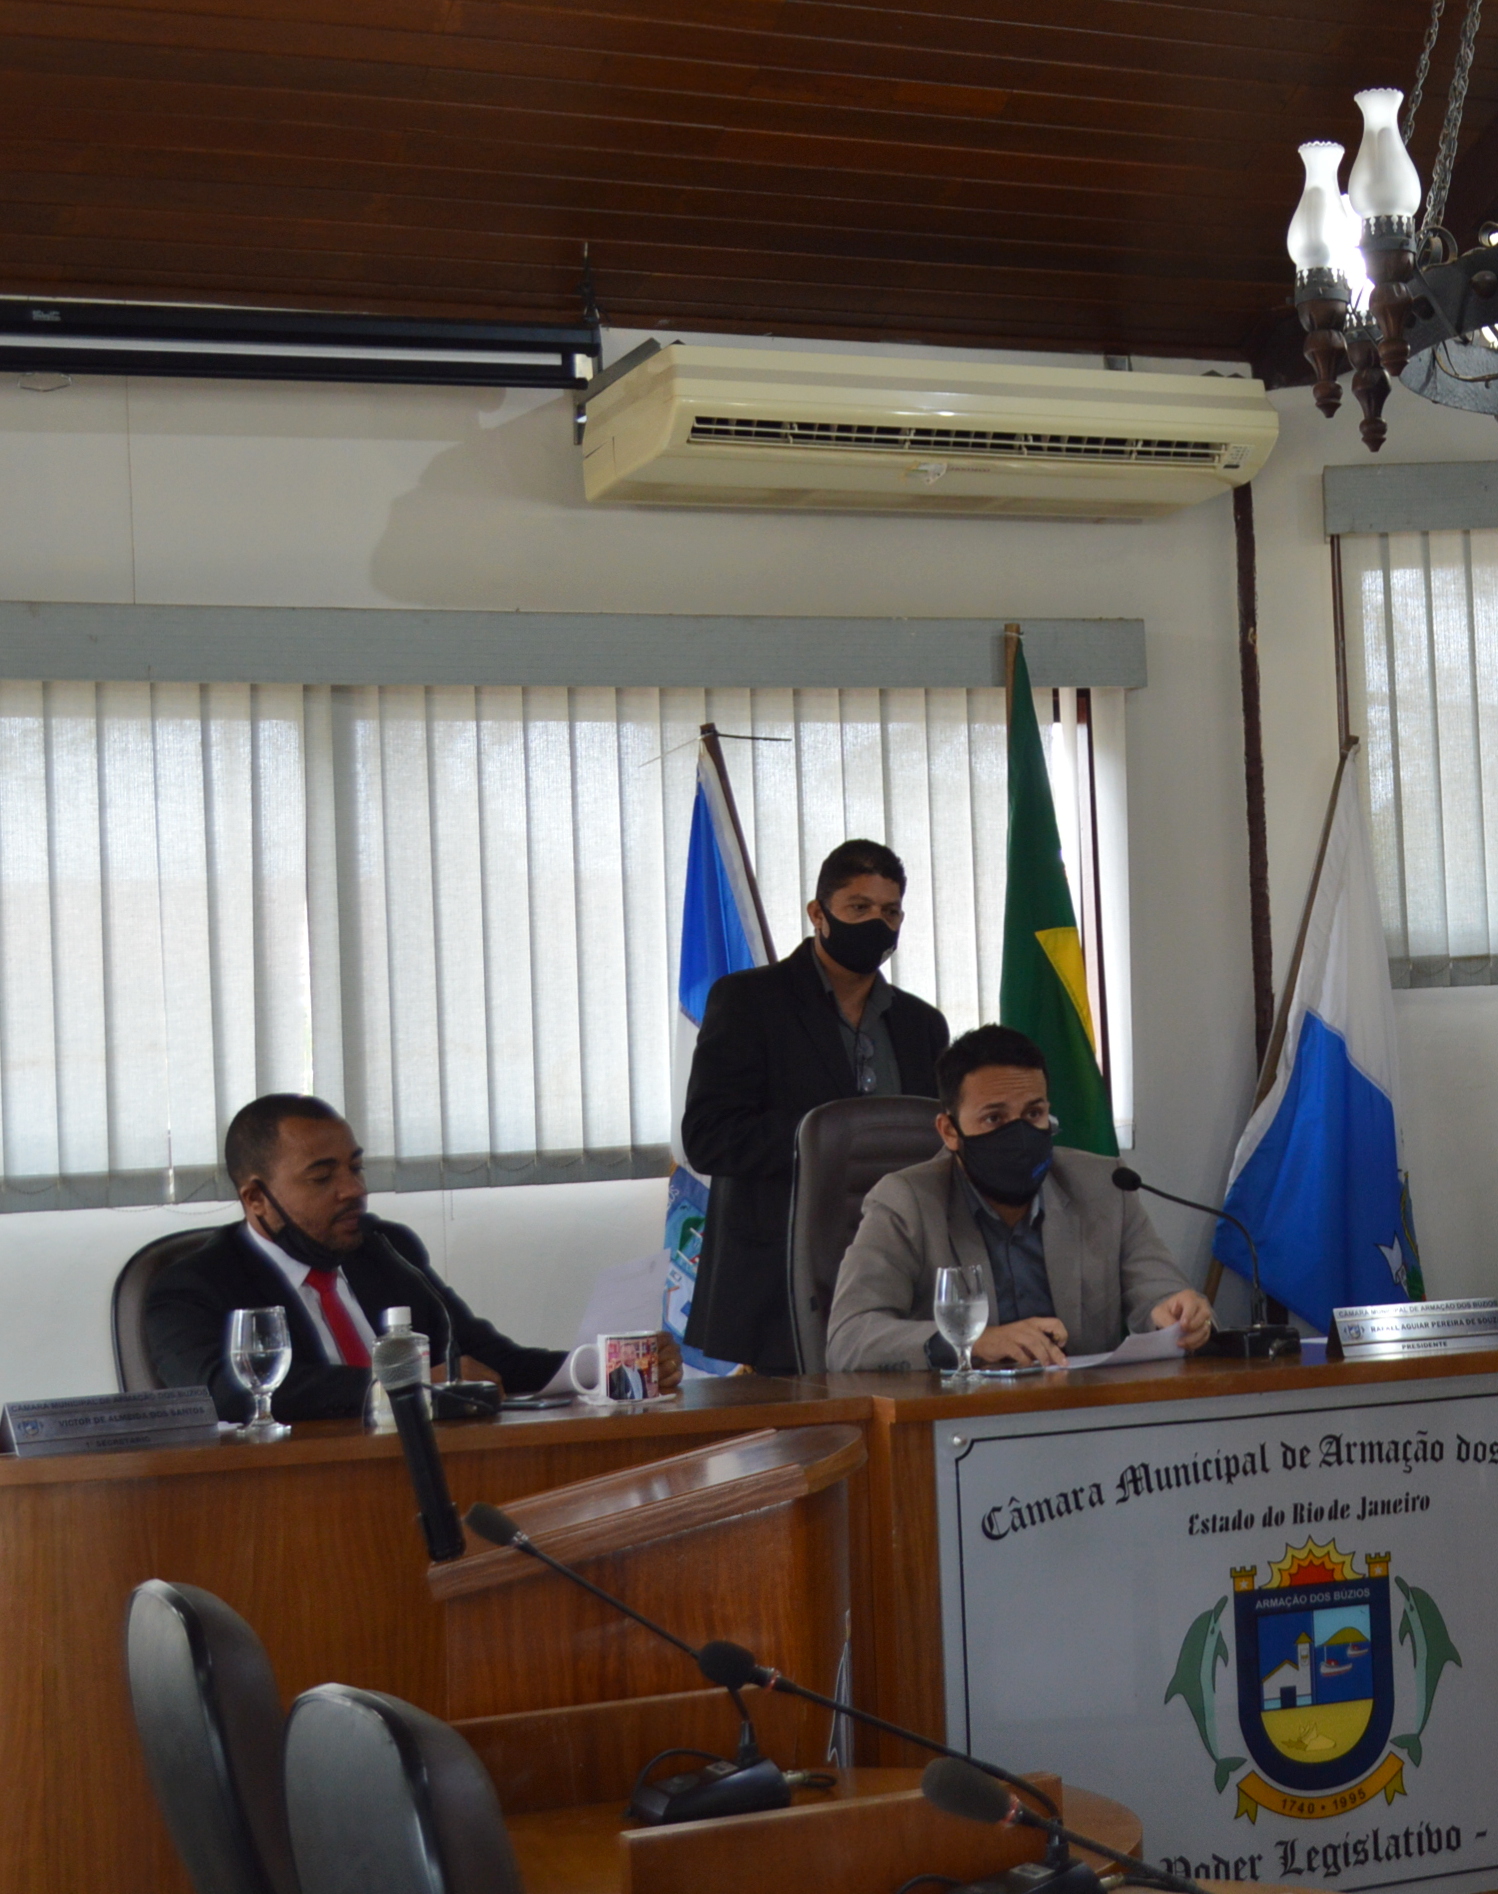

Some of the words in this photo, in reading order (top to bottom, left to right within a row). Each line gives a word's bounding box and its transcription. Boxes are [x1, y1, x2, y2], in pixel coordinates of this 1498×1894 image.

[1401, 1320, 1430, 1331] AGUIAR
[1431, 1317, 1465, 1329] PEREIRA
[1465, 1317, 1476, 1326] DE
[1402, 1341, 1448, 1350] PRESIDENTE
[58, 1416, 92, 1428] VICTOR
[93, 1415, 106, 1425] DE
[108, 1411, 149, 1422] ALMEIDA
[149, 1408, 169, 1419] DOS
[170, 1406, 206, 1417] SANTOS
[981, 1483, 1106, 1541] Câmara
[1115, 1442, 1271, 1505] Municipal
[1281, 1440, 1312, 1471] de
[1318, 1430, 1445, 1474] Armação
[1188, 1507, 1255, 1536] Estado
[1262, 1505, 1285, 1528] do
[1356, 1491, 1431, 1521] Janeiro
[1255, 1593, 1308, 1610] ARMAÇÃO
[1309, 1591, 1332, 1604] DOS
[1333, 1587, 1371, 1602] BÚZIOS
[1282, 1798, 1315, 1815] 1740
[1332, 1788, 1366, 1810] 1995
[1275, 1821, 1462, 1878] Legislativo
